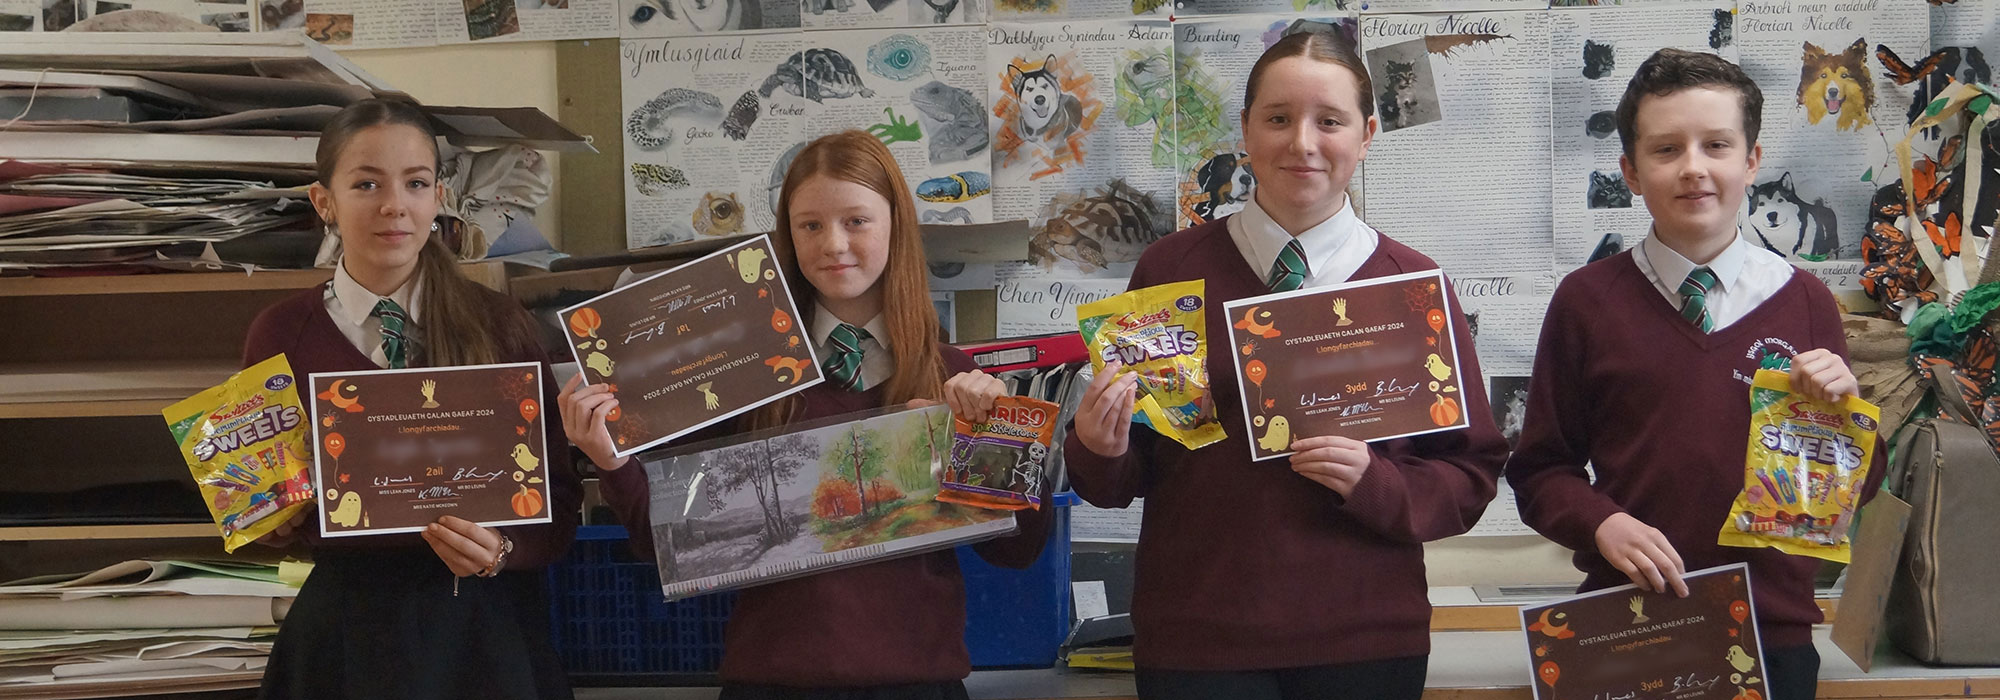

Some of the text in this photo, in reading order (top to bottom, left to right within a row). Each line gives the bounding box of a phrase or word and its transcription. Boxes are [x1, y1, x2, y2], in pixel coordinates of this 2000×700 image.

[1363, 16, 1429, 38] Florian
[1742, 17, 1793, 33] Florian
[988, 26, 1054, 51] Datblygu
[1058, 25, 1116, 49] Syniadau
[1183, 25, 1241, 49] Bunting
[623, 38, 745, 78] Ymlusgiaid
[1000, 281, 1043, 304] Chen
[1183, 298, 1195, 307] 18
[1285, 322, 1404, 346] CYSTADLEUAETH CALAN GAEAF 2024
[1102, 324, 1198, 367] SWEETS
[683, 372, 706, 386] CALAN
[1345, 381, 1367, 395] 3ydd
[643, 389, 660, 401] 2024
[367, 413, 426, 422] CYSTADLEUAETH
[426, 411, 450, 420] CALAN
[452, 410, 475, 418] GAEAF
[990, 406, 1047, 428] RIBO
[192, 404, 301, 462] SWEETS
[1760, 424, 1866, 471] SWEETS
[1637, 624, 1661, 634] CALAN
[1686, 615, 1705, 625] 2024
[1640, 679, 1664, 692] 3ydd
